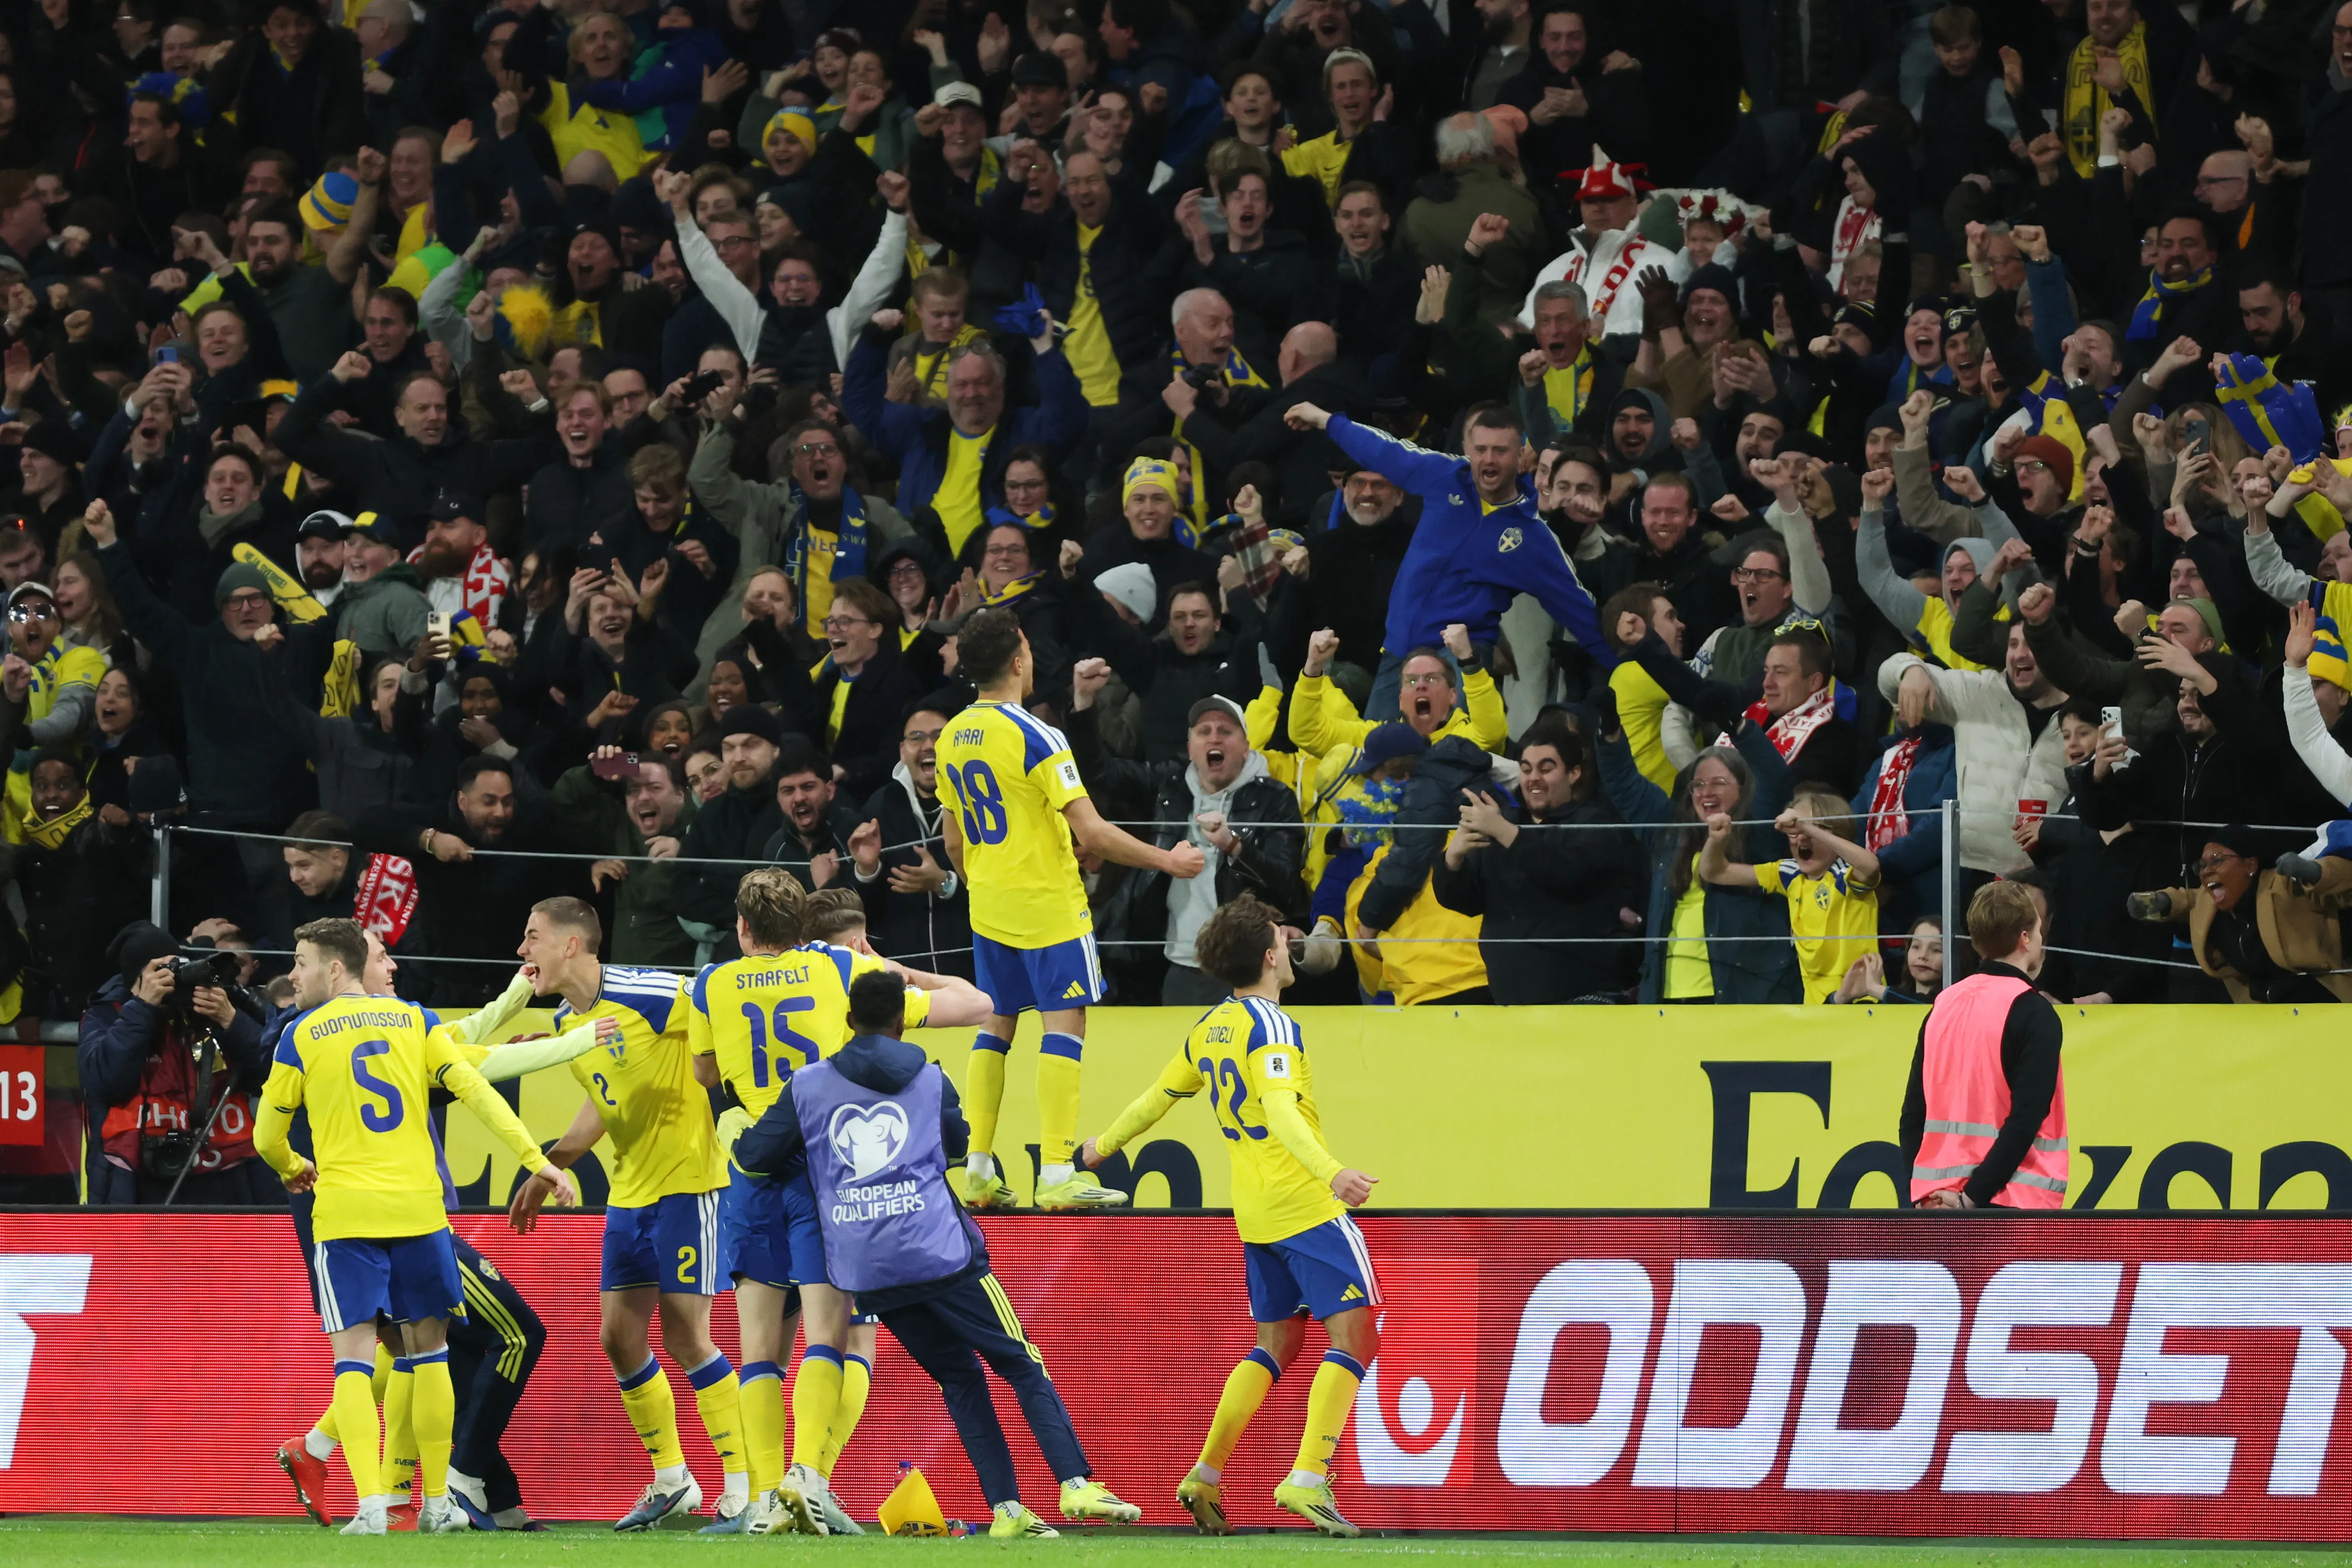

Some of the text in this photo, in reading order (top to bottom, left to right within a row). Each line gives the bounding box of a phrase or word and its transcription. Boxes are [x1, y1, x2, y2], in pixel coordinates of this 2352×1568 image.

[953, 728, 984, 747] AYARI
[946, 760, 1007, 845] 18
[736, 965, 809, 989] STARFELT
[310, 1012, 413, 1040] GUDMUNDSSON
[741, 996, 820, 1087] 15
[1206, 1026, 1234, 1044] ZENELI
[0, 1071, 37, 1120] 13
[351, 1040, 404, 1133] 5
[593, 1072, 617, 1105] 2
[1198, 1057, 1268, 1141] 22
[832, 1193, 925, 1225] QUALIFIERS
[836, 1179, 916, 1204] EUROPEAN
[677, 1246, 696, 1283] 2
[1497, 1257, 2352, 1496] ODDSET
